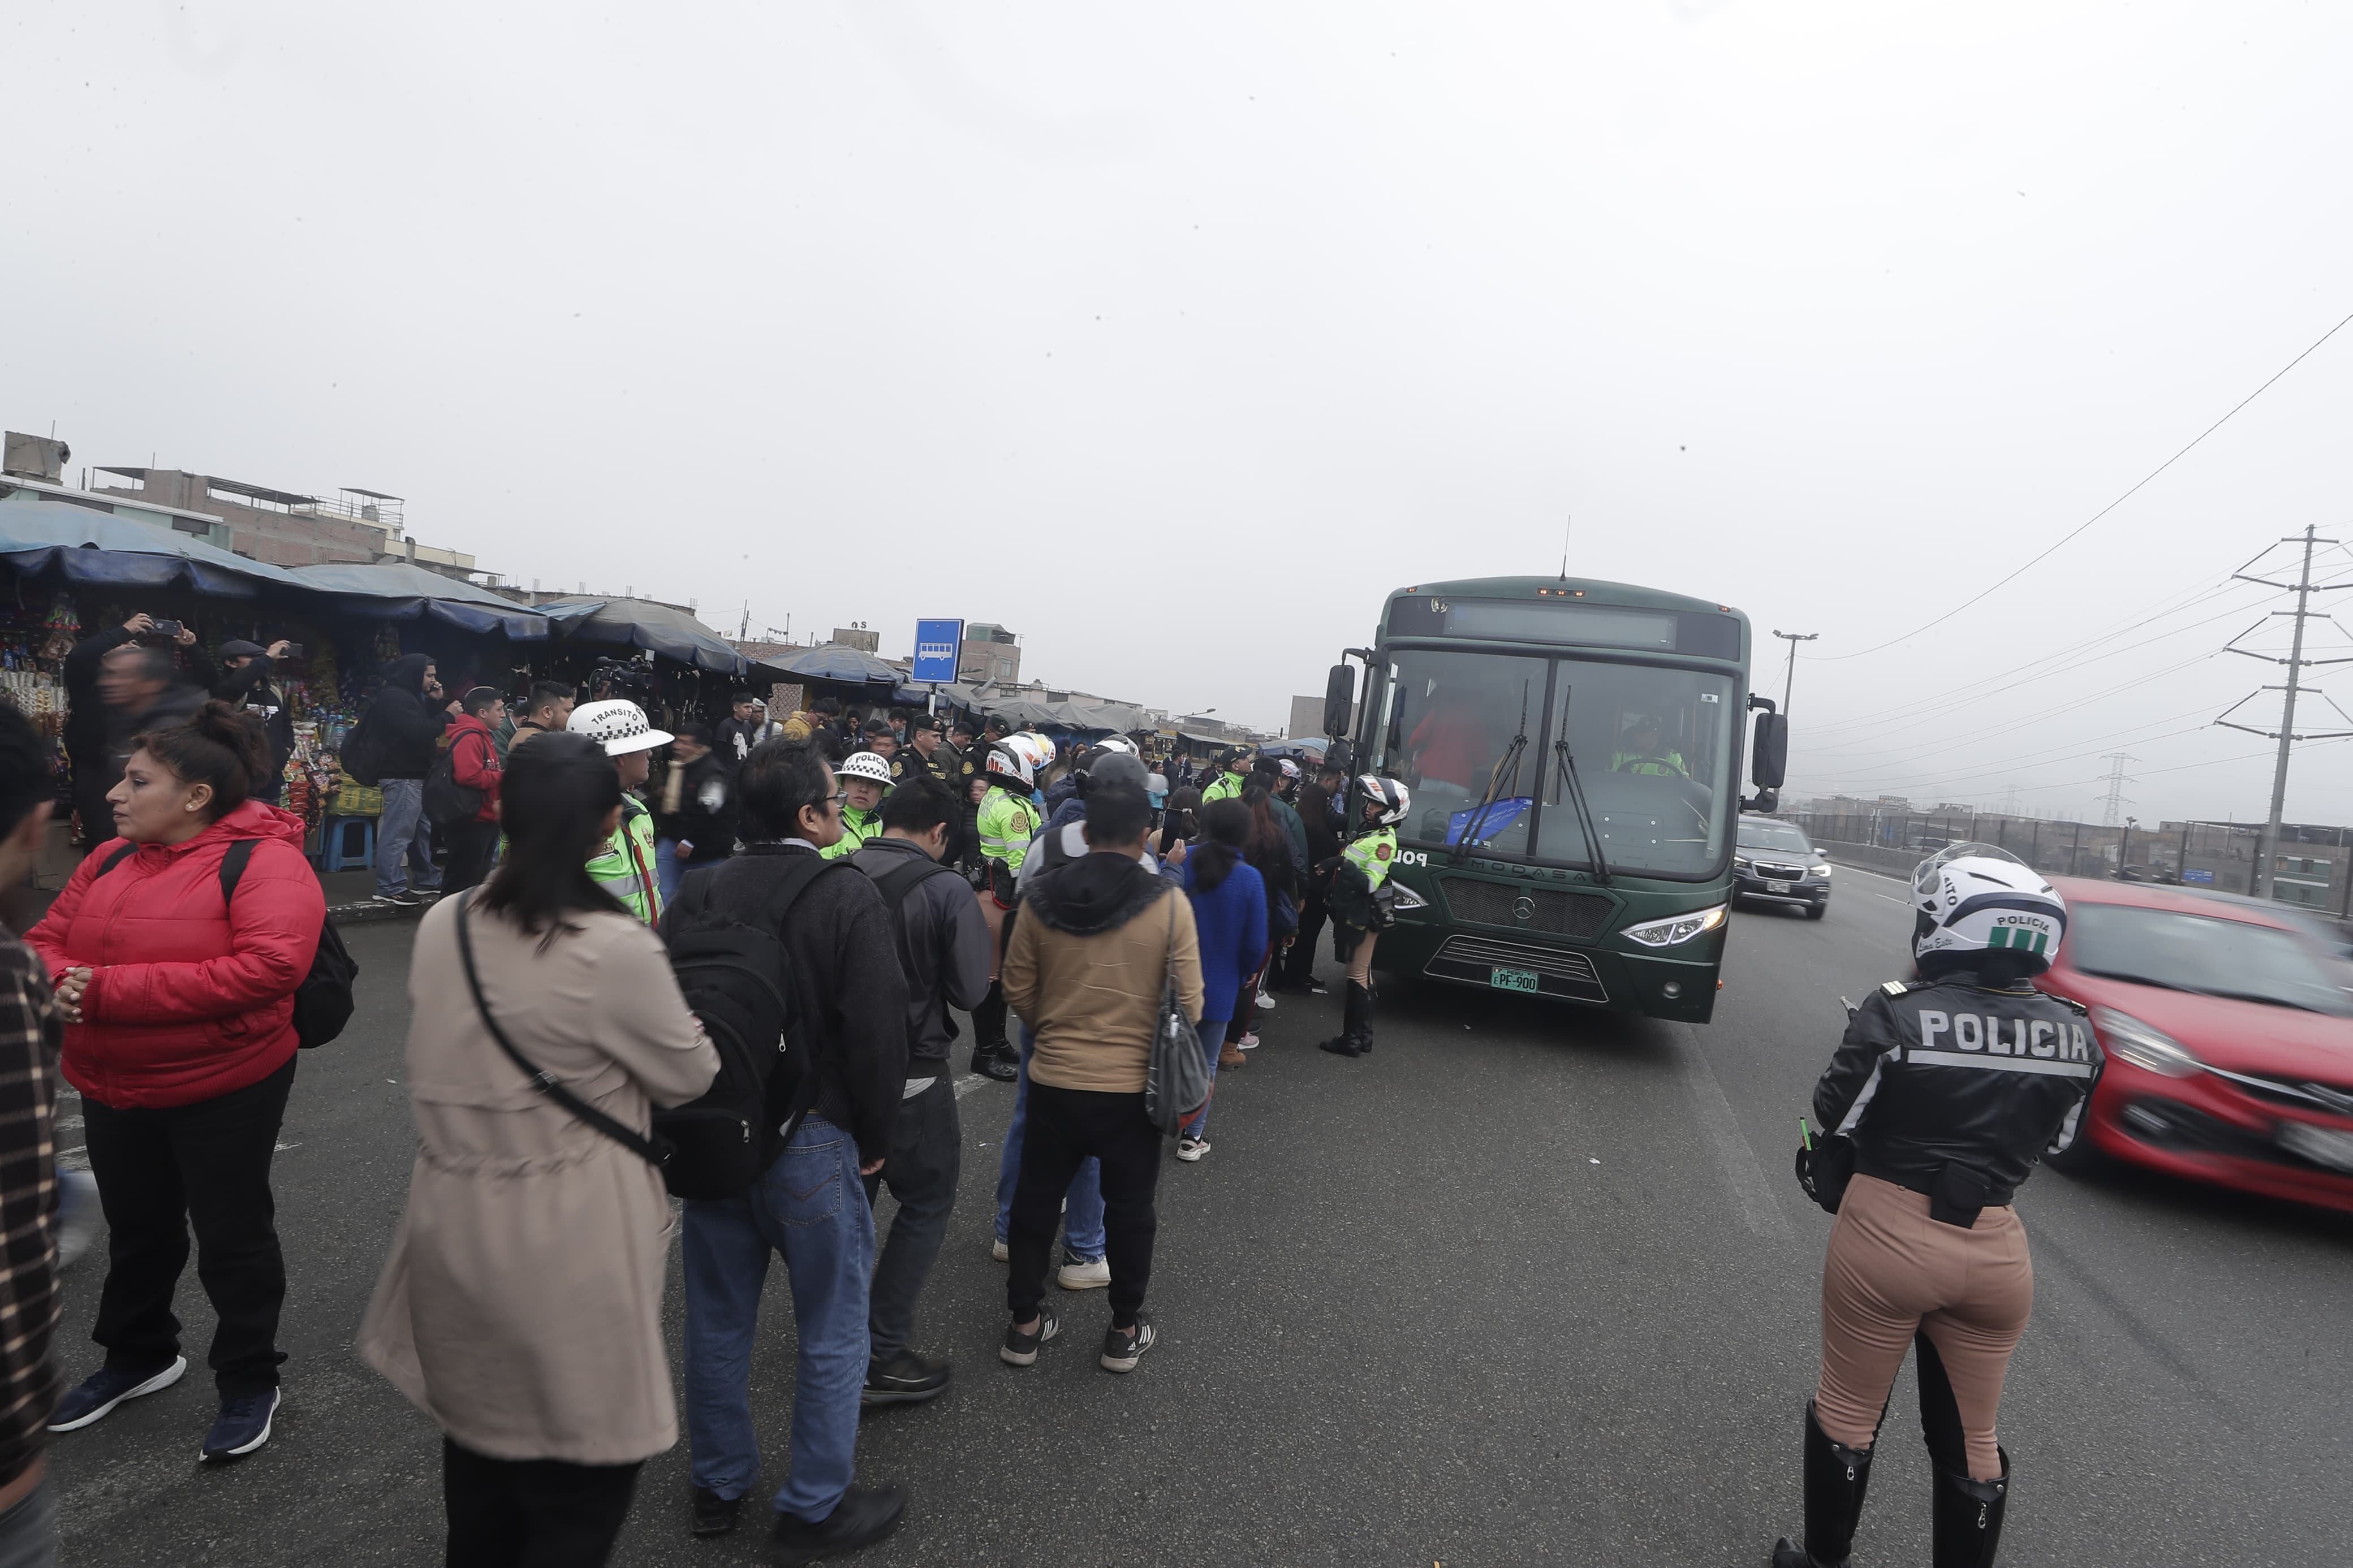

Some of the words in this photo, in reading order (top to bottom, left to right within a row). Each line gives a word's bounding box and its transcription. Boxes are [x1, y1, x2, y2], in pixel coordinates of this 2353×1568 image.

[591, 709, 637, 725] TRANSITO
[855, 755, 887, 772] POLICIA
[1471, 859, 1586, 882] MODASA
[1997, 915, 2049, 933] POLICIA
[1919, 1009, 2088, 1061] POLICIA
